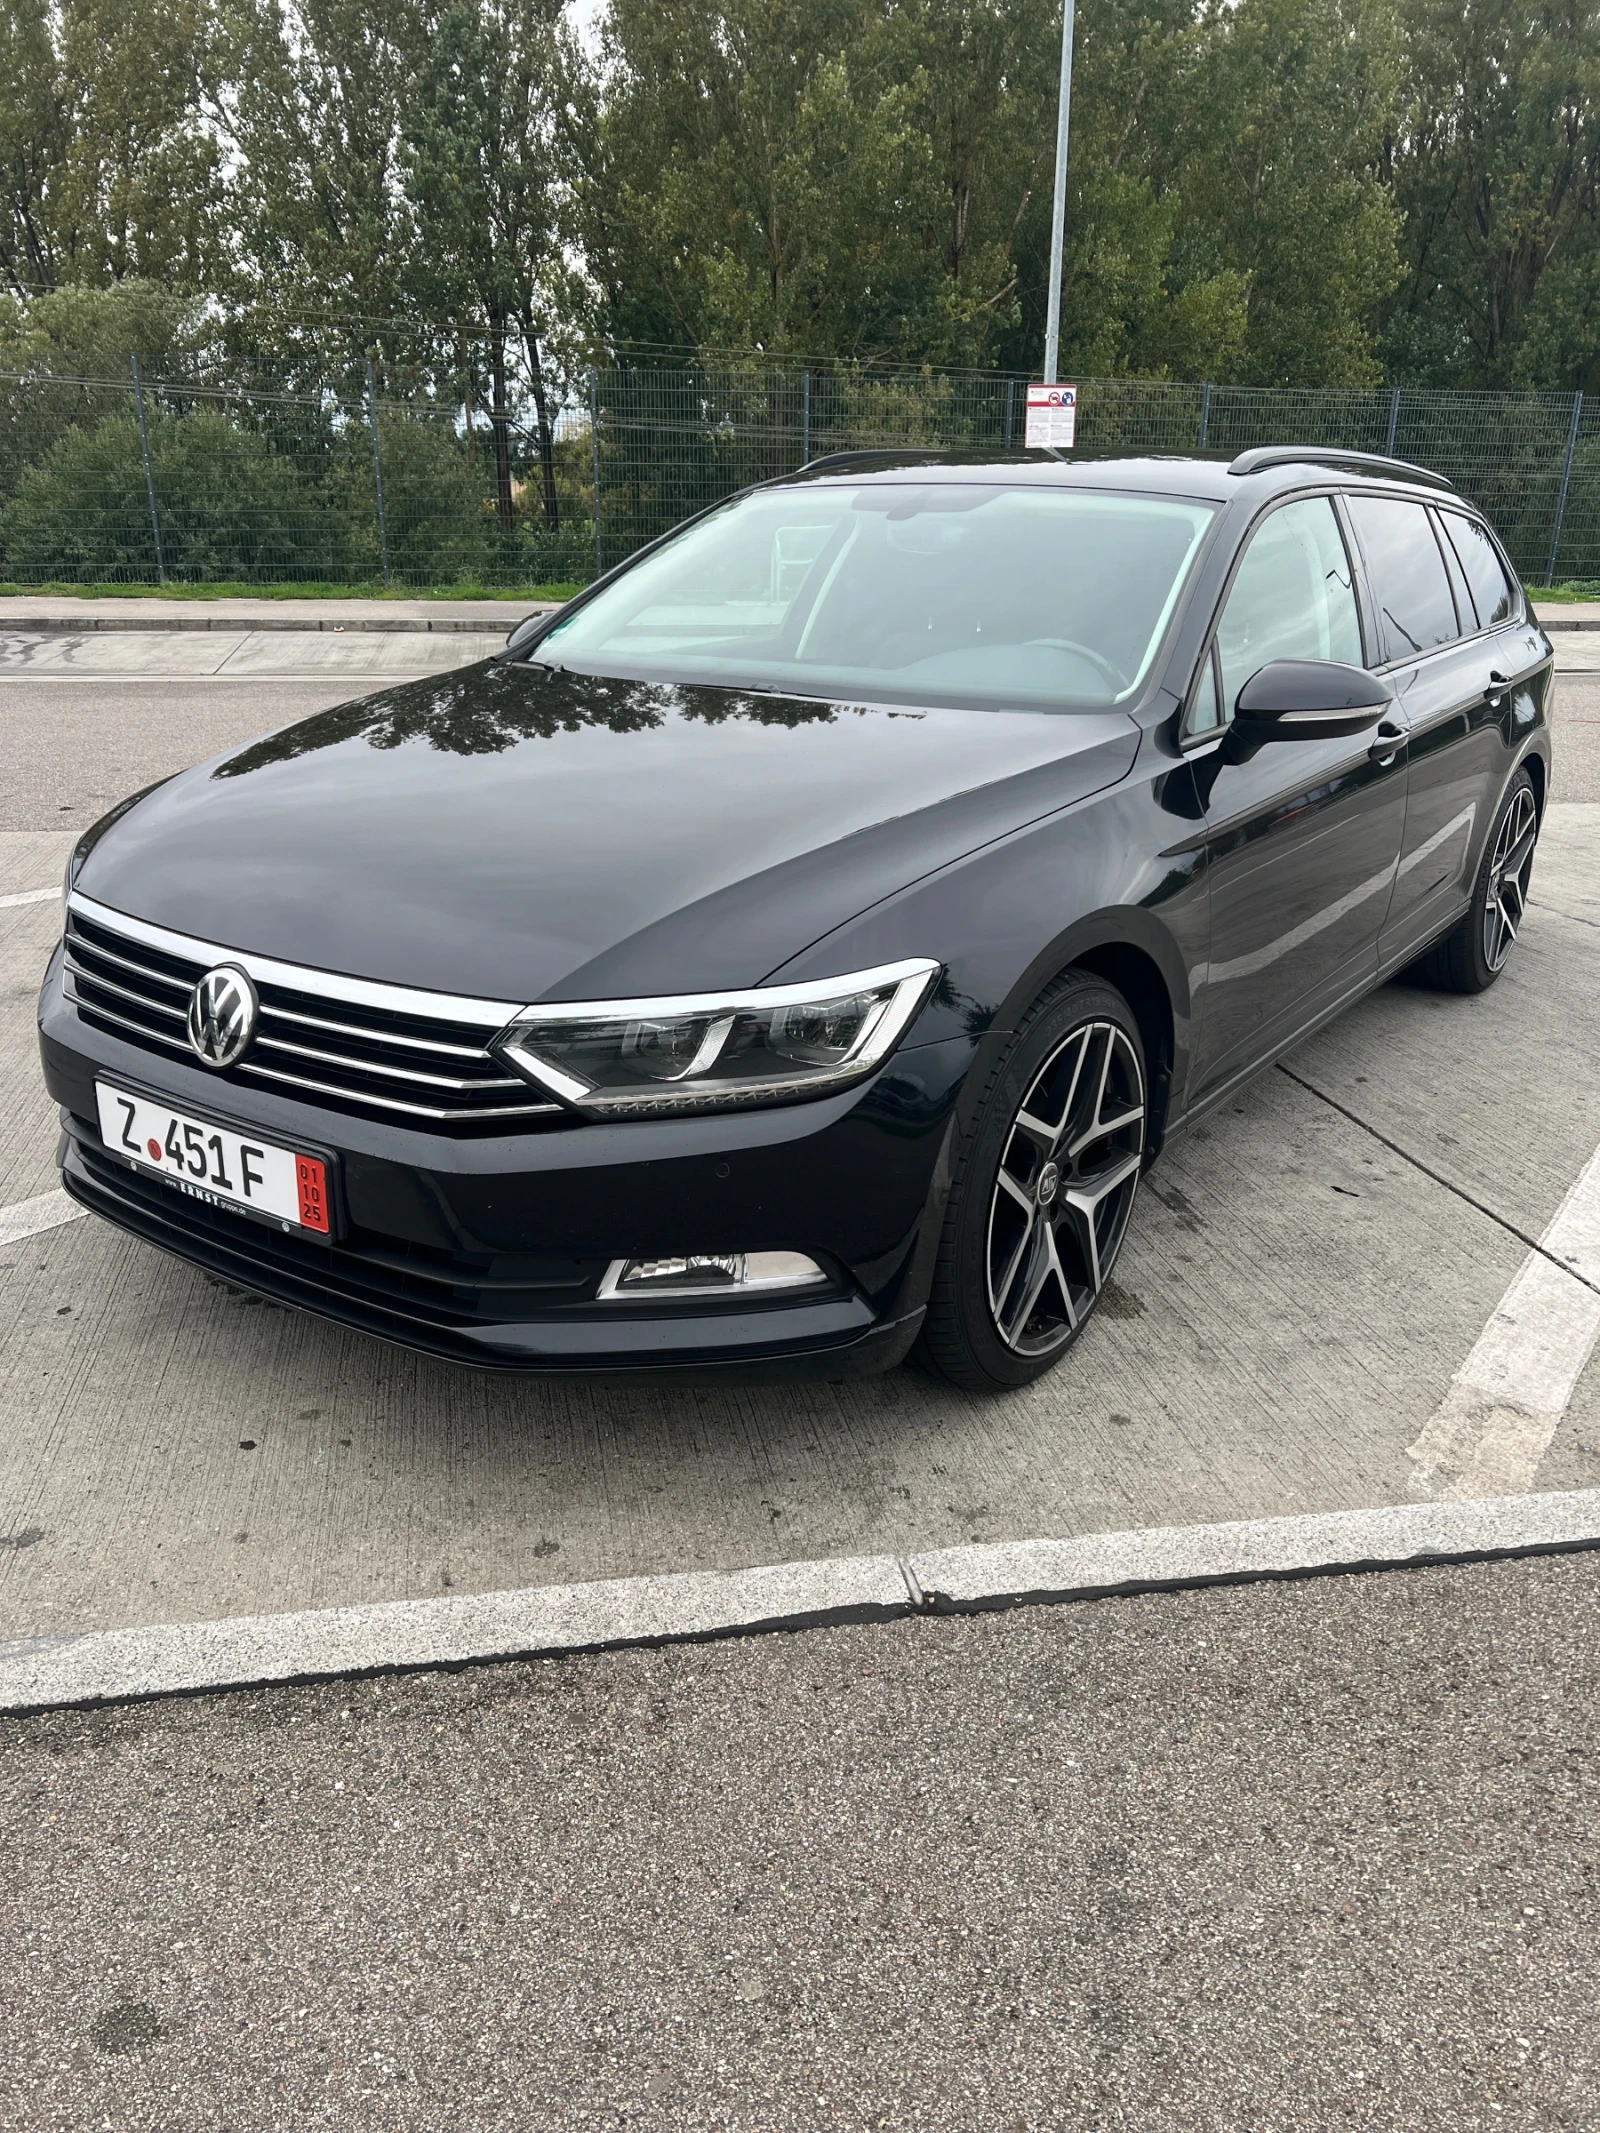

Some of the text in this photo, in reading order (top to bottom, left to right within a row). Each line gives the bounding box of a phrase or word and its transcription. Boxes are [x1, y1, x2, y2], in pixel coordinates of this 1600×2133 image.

[1477, 839, 1494, 904] KUMHO
[116, 1097, 264, 1197] Z 451 F
[300, 1163, 317, 1183] 01
[180, 1182, 218, 1206] ERNST
[303, 1183, 319, 1202] 10
[303, 1202, 321, 1221] 25
